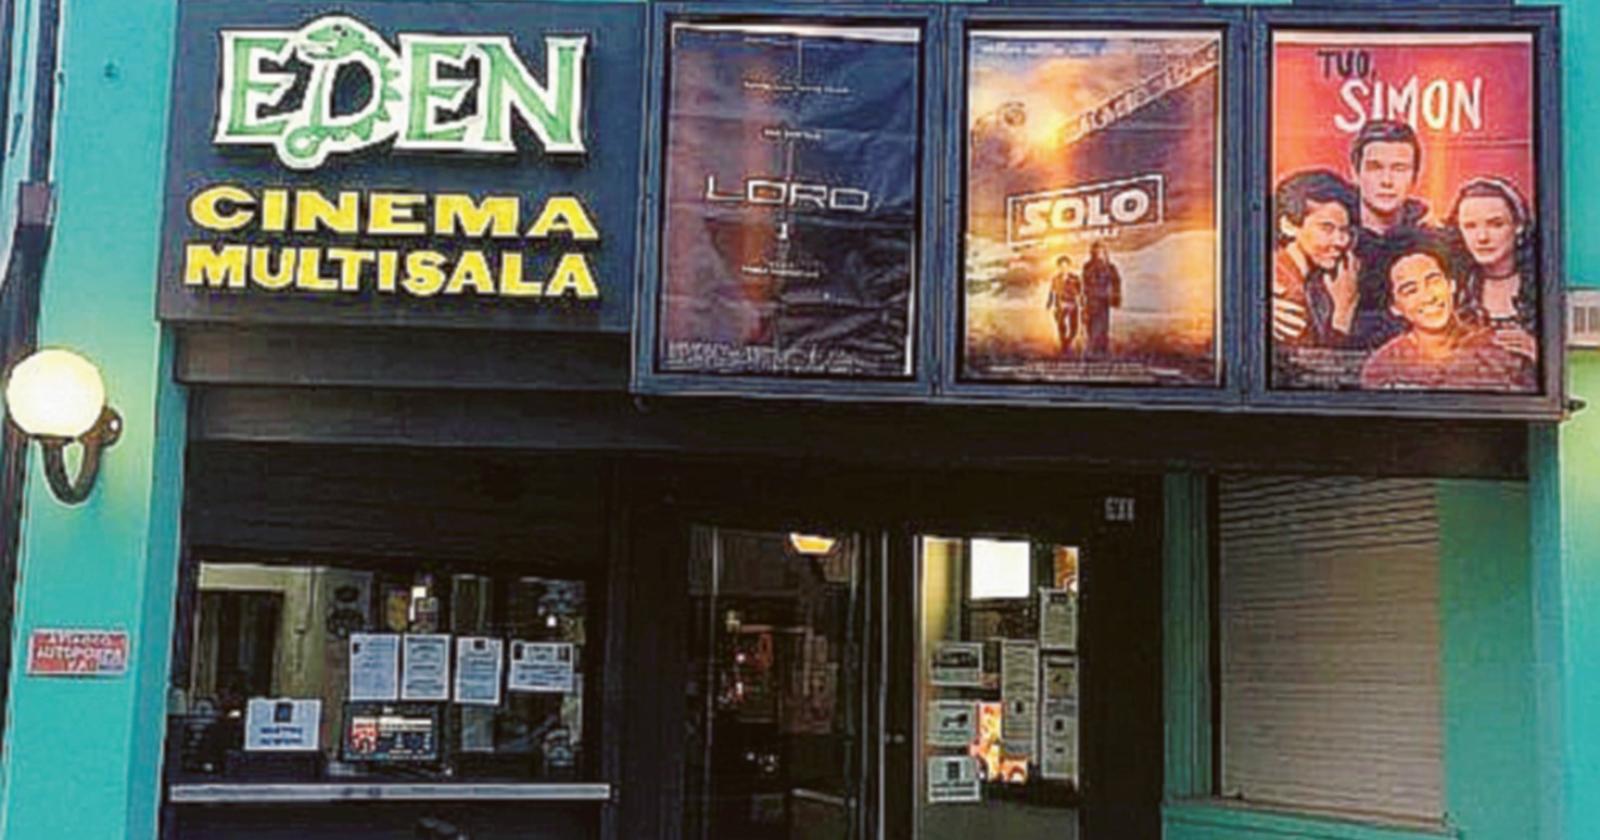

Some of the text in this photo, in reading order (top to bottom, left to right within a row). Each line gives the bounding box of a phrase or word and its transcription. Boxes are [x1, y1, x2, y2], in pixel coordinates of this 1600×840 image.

[213, 17, 587, 168] EDEN
[1333, 75, 1484, 133] SIMON
[190, 187, 598, 239] CINEMA
[706, 175, 869, 212] LORO
[1019, 189, 1150, 236] SOLO
[183, 244, 598, 297] MULTISALA
